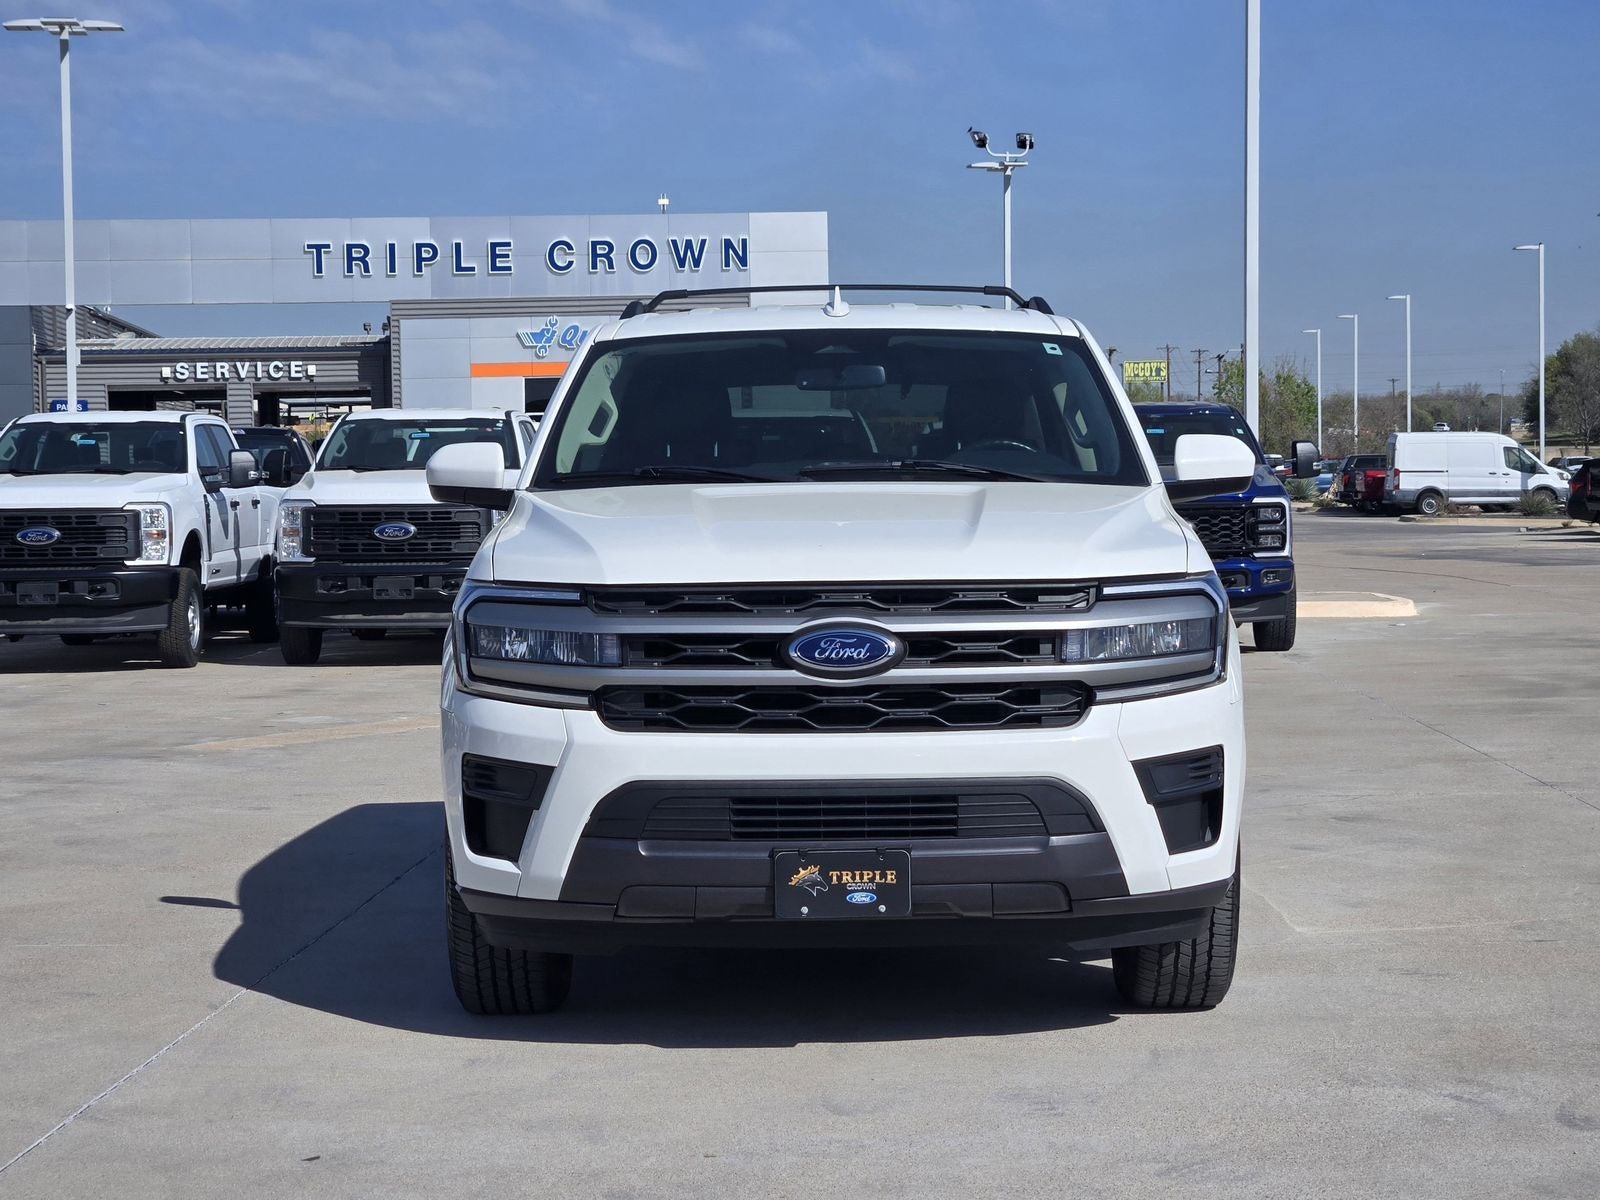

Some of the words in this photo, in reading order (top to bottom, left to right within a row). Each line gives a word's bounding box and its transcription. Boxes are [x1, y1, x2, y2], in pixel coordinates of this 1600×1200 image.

[305, 240, 514, 276] TRIPLE
[546, 236, 750, 273] CROWN
[175, 361, 303, 379] SERVICE
[56, 403, 83, 411] PAS
[26, 531, 48, 541] Ford
[383, 527, 405, 537] Ford
[815, 638, 870, 660] Ford
[829, 870, 897, 885] TRIPLE
